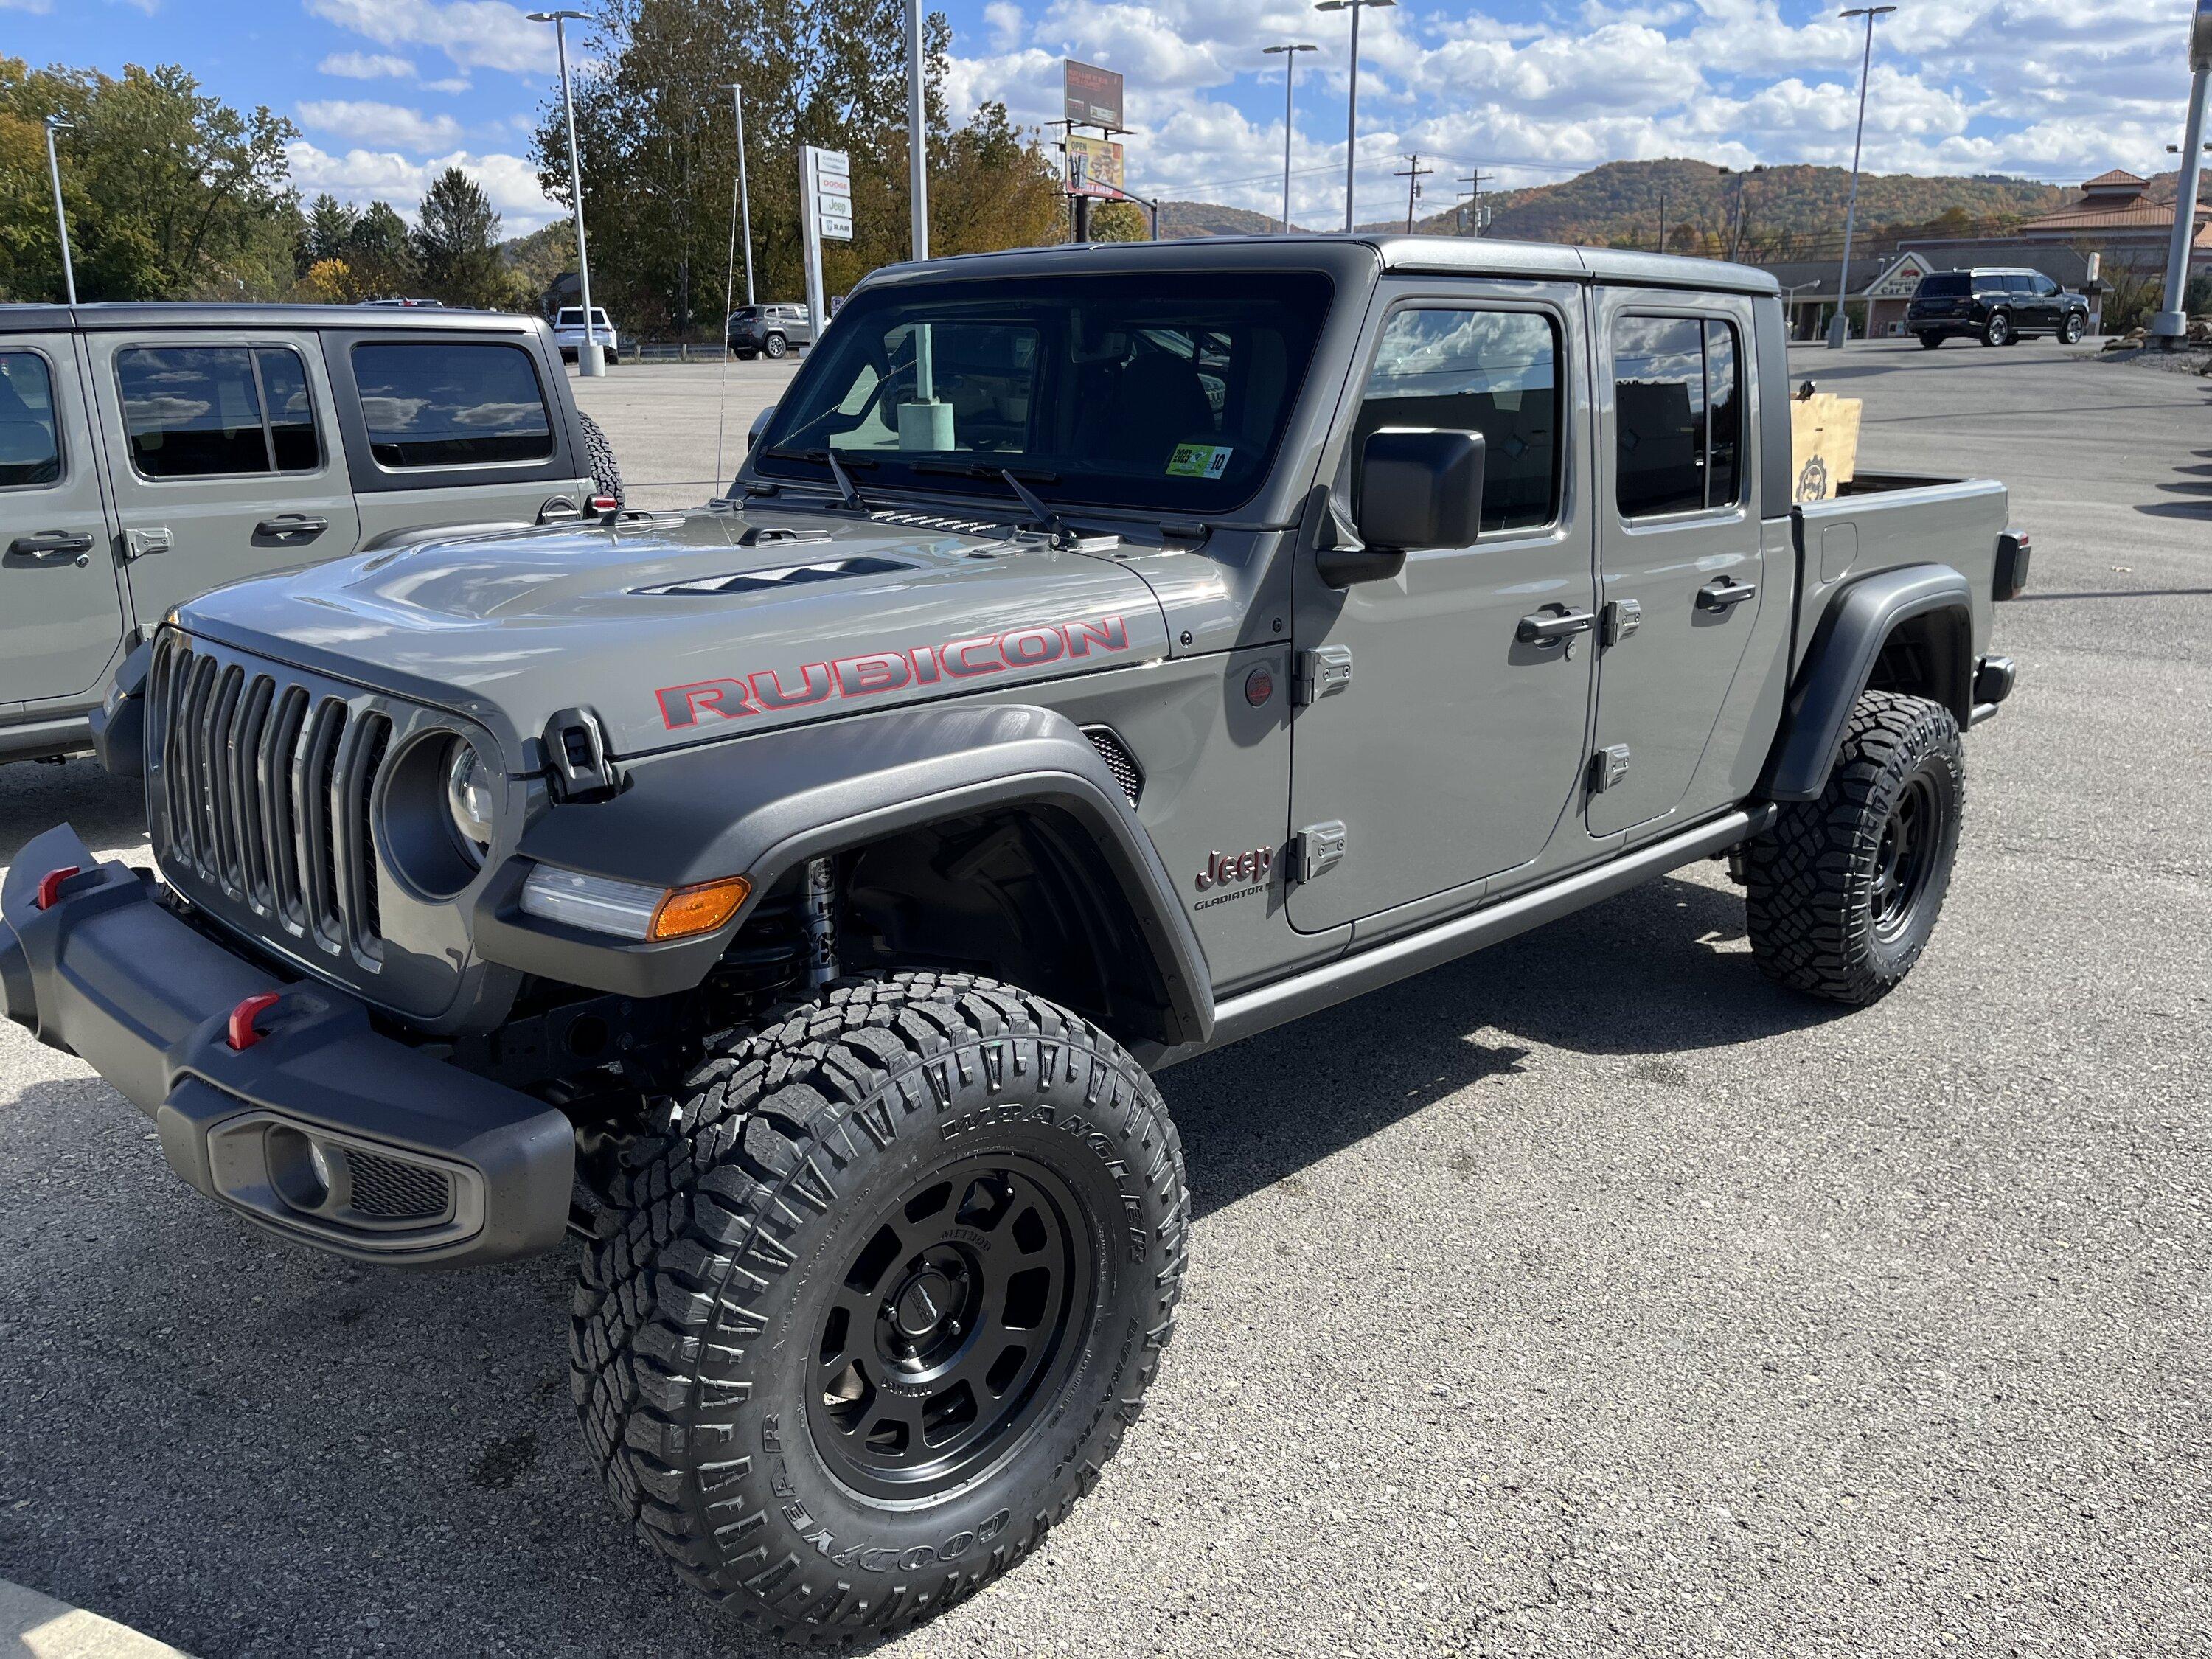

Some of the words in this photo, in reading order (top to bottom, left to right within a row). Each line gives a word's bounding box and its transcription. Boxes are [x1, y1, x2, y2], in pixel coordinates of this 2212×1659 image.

[1071, 141, 1088, 151] OPEN
[823, 180, 847, 190] DODGE
[829, 198, 846, 215] Jeep
[833, 223, 849, 232] RAM
[1881, 286, 1901, 294] Car
[1211, 453, 1225, 470] 10
[655, 615, 1130, 731] RUBICON
[1196, 846, 1273, 891] Jeep
[1194, 884, 1264, 911] GLADIATOR
[940, 1103, 1147, 1263] WRANGLER
[939, 1228, 992, 1252] METHOD
[762, 1413, 1011, 1573] GOODYEAR
